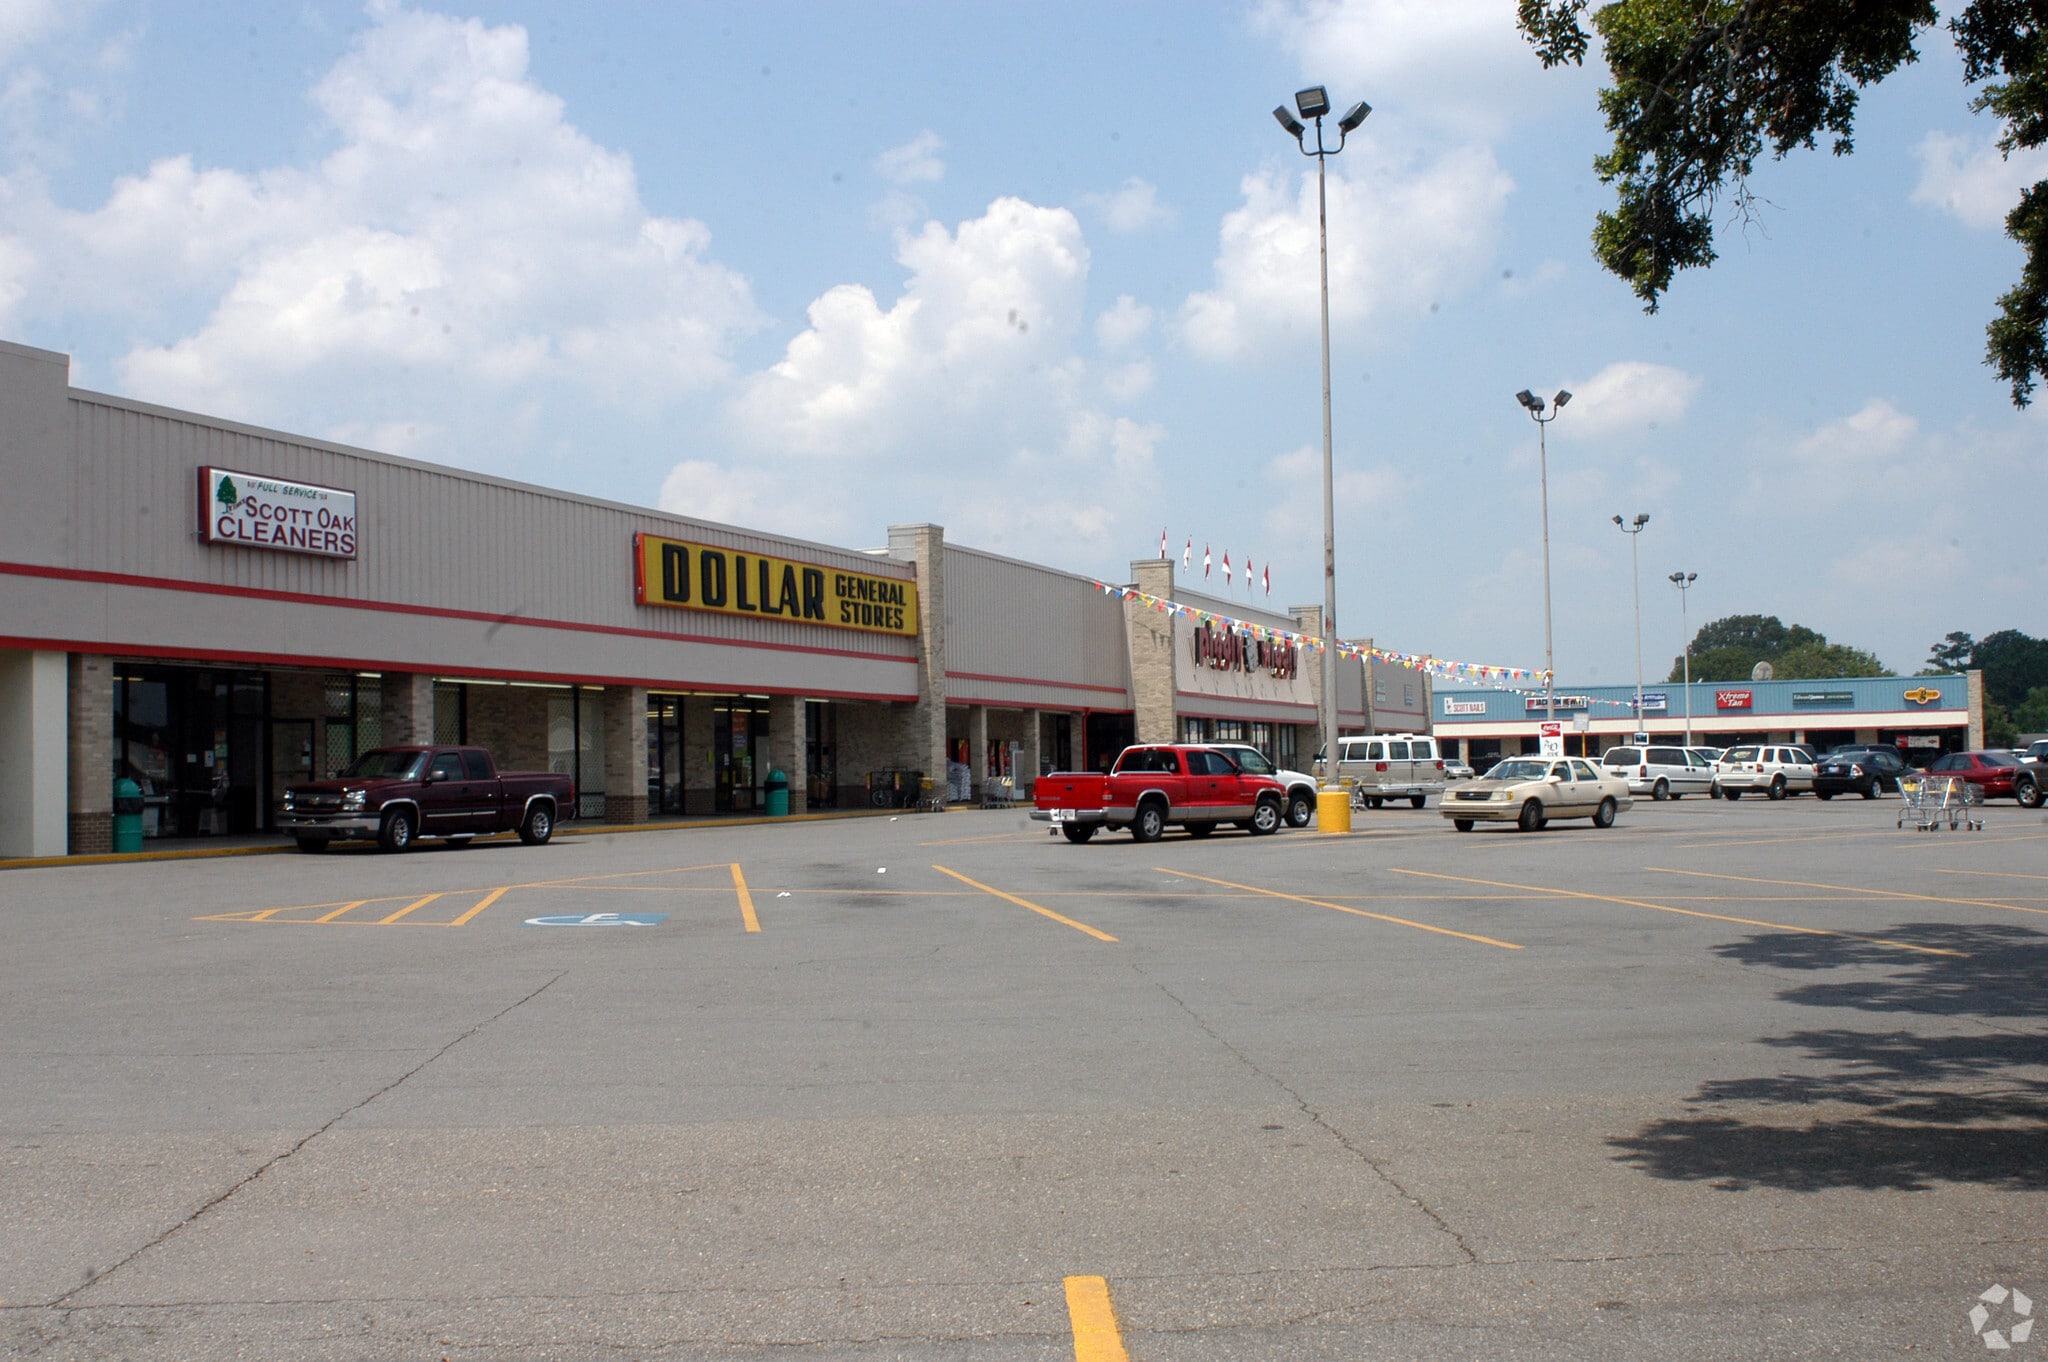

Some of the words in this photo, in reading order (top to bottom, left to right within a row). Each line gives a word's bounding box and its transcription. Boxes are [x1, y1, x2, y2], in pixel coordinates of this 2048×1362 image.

[257, 480, 278, 493] FULL
[283, 486, 318, 499] SERVICE
[245, 495, 313, 526] SCOTT
[317, 507, 354, 532] OAK
[217, 515, 355, 554] CLEANERS
[661, 542, 826, 620] DOLLAR
[835, 573, 906, 607] GENERAL
[840, 600, 904, 630] STORES
